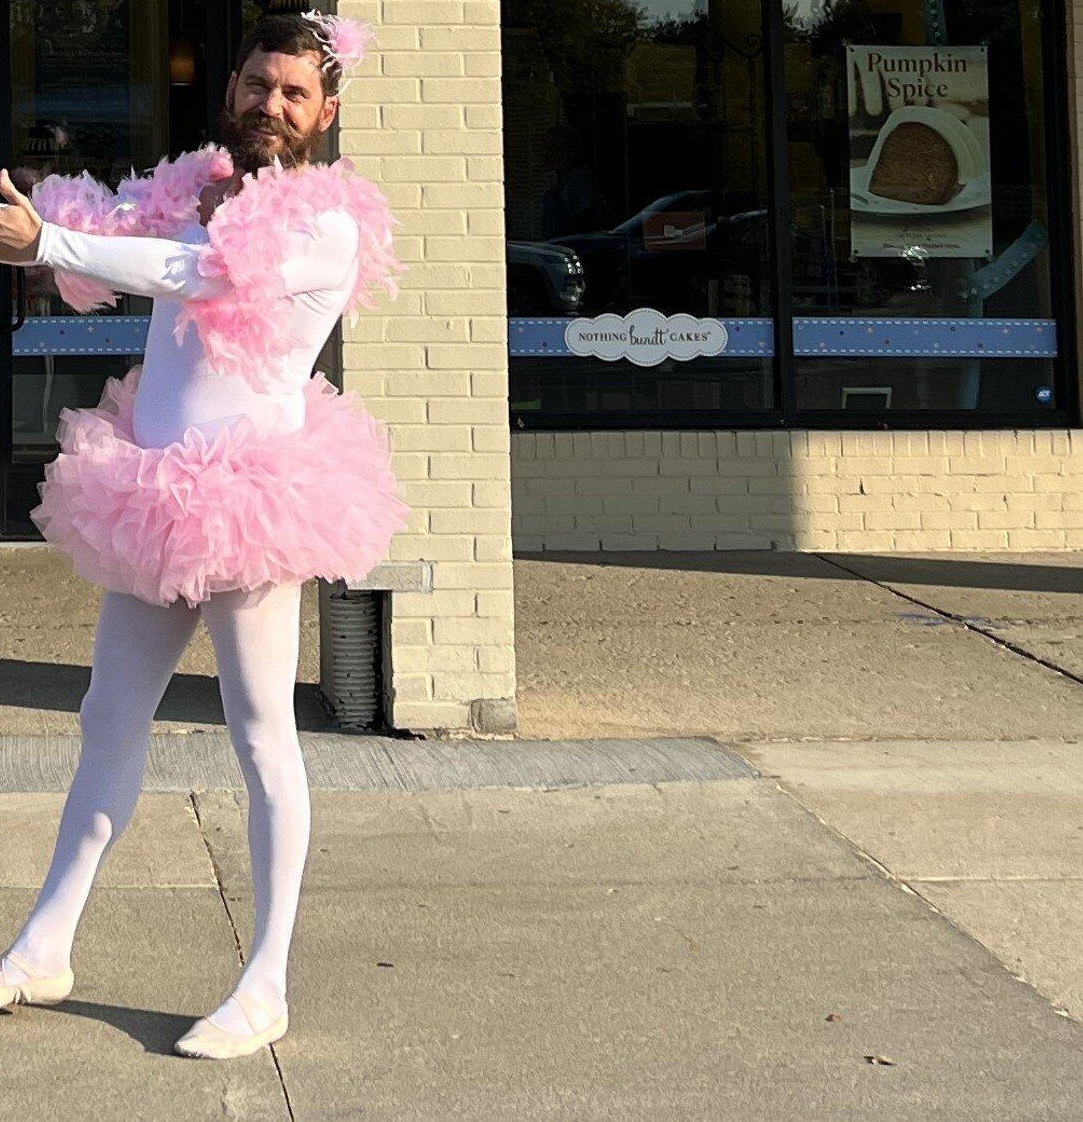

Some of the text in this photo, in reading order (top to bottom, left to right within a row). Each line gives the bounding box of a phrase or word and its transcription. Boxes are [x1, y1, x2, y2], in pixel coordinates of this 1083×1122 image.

[867, 52, 967, 78] Pumpkin
[887, 77, 949, 105] Spice
[578, 324, 708, 346] NOTHING bundt CAKES
